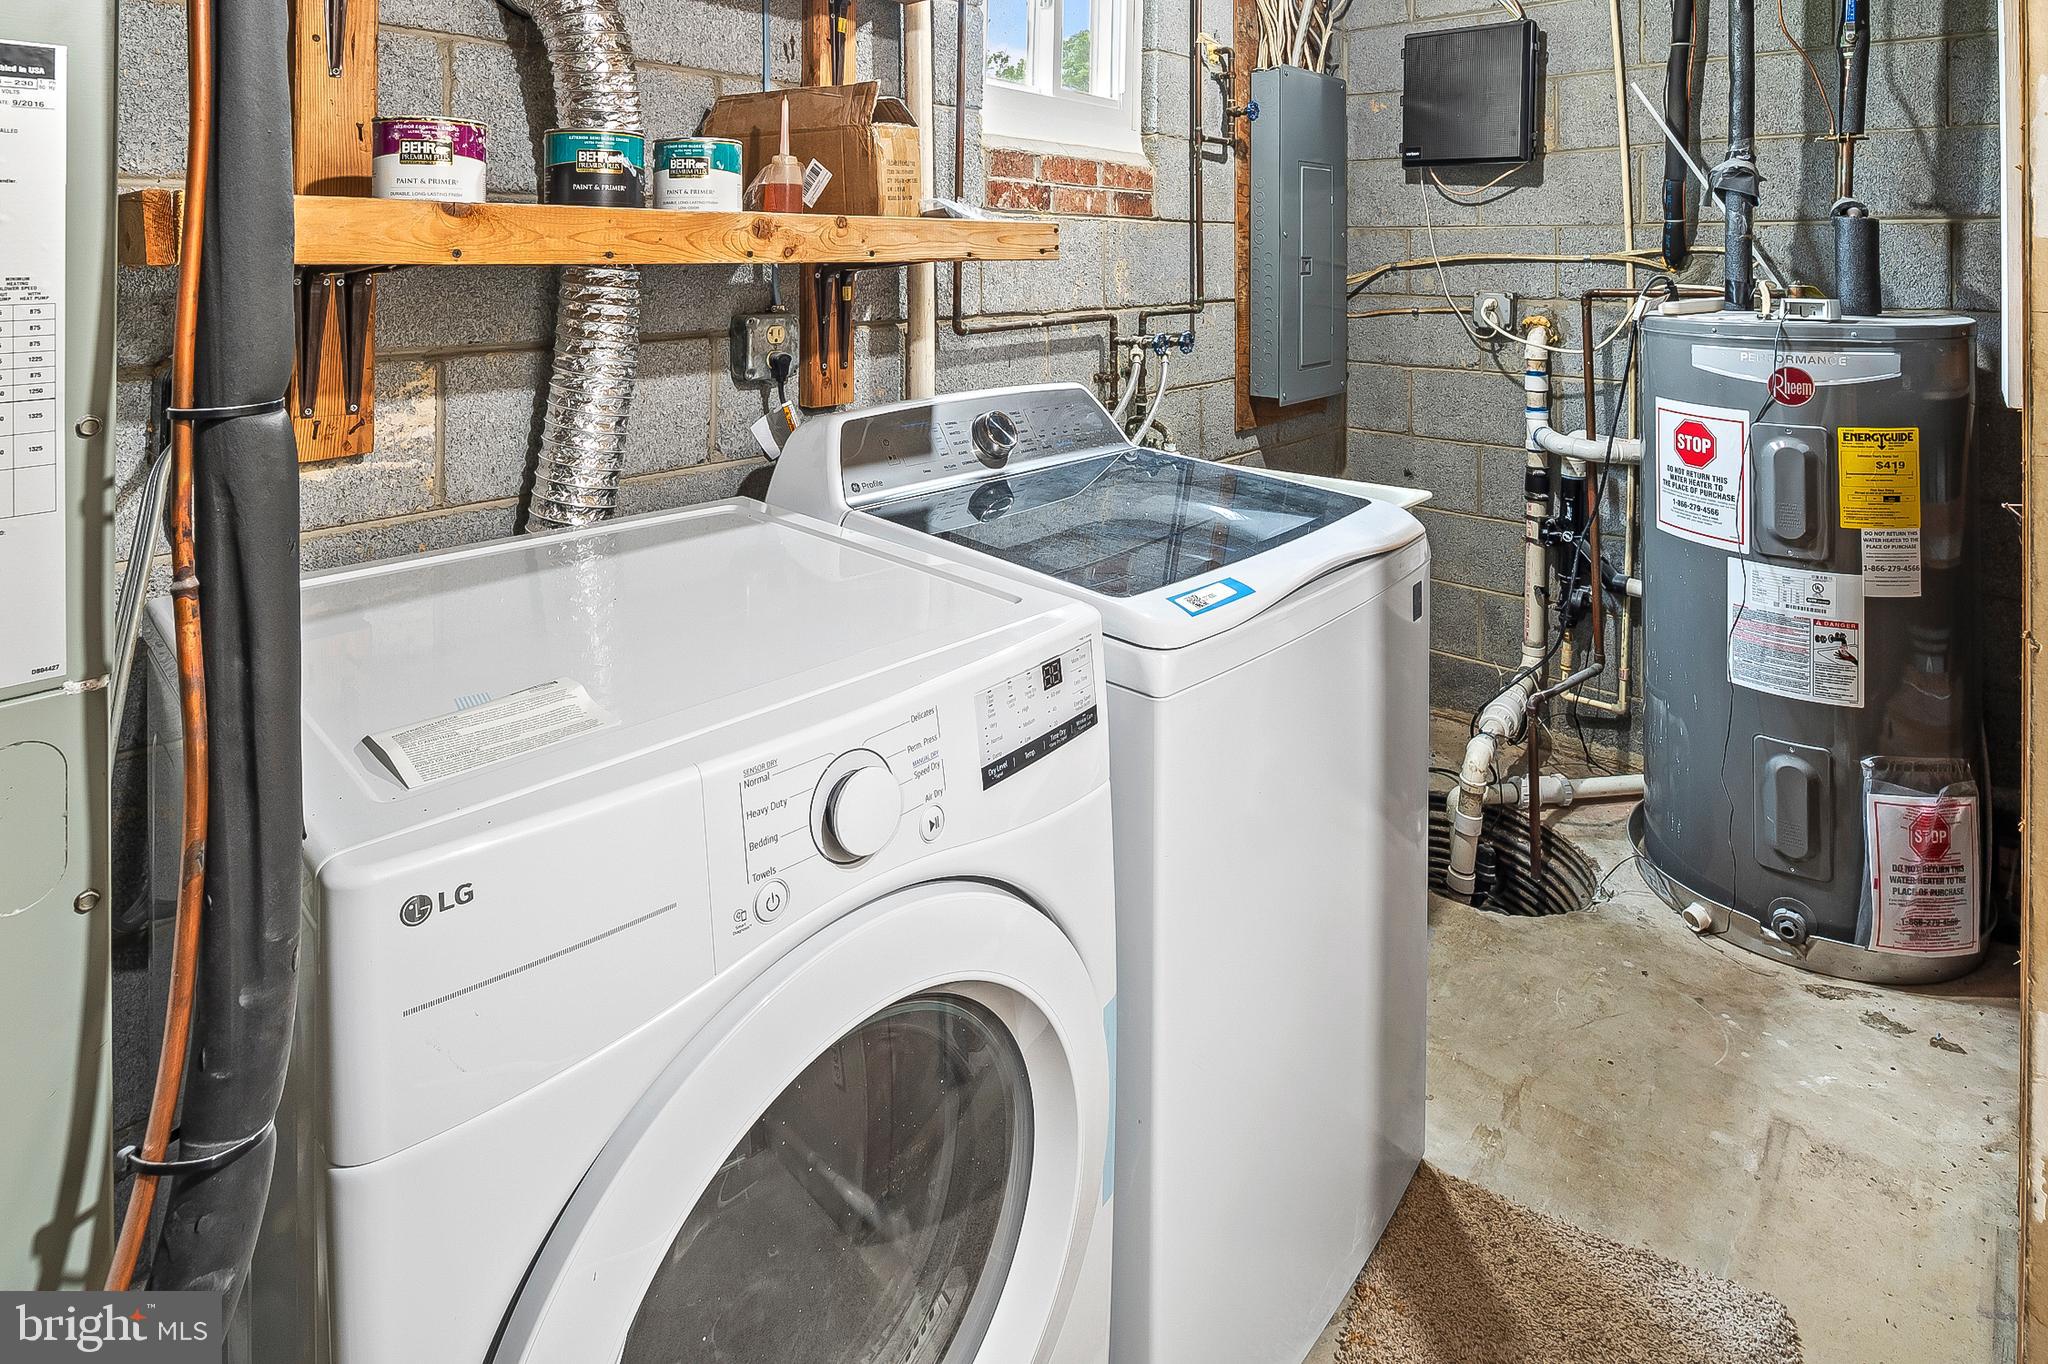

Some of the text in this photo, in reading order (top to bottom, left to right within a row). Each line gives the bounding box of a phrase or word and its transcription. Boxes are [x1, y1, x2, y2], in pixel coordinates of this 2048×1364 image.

[28, 66, 46, 75] USA
[12, 100, 45, 108] 9/2016
[401, 142, 436, 154] BEHR
[578, 151, 609, 162] BEHR
[670, 158, 696, 169] BEHR
[1774, 368, 1813, 400] Rheem
[1677, 433, 1712, 454] STOP
[1842, 432, 1914, 442] ENERGYGUIDE
[1875, 461, 1905, 470] $419
[1666, 464, 1728, 485] DO NOT RETURN THIS
[1669, 473, 1723, 492] WATER HEATER TO
[861, 480, 884, 490] Profile
[1662, 478, 1671, 487] THE
[1671, 479, 1690, 492] PLACE
[1689, 484, 1698, 494] OF
[1699, 488, 1736, 503] PURCHASE
[1672, 498, 1720, 517] 1-866-279-4566
[1823, 621, 1856, 629] DANGER
[910, 707, 935, 724] Delicates
[923, 734, 938, 746] Press
[912, 750, 939, 767] MANUAL DRY
[742, 759, 778, 777] SENSOR DRY
[913, 760, 940, 780] Speed Dry
[987, 767, 997, 777] Dry
[996, 760, 1009, 771] Level
[743, 771, 770, 789] Normal
[924, 788, 944, 804] Air Dry
[746, 798, 788, 820] Heavy Duty
[749, 833, 779, 852] Bedding
[1914, 829, 1947, 844] STOP
[752, 866, 777, 883] Towels
[1889, 875, 1916, 885] WATER
[1946, 876, 1955, 885] TO
[1955, 875, 1967, 884] THE
[438, 882, 474, 912] LG
